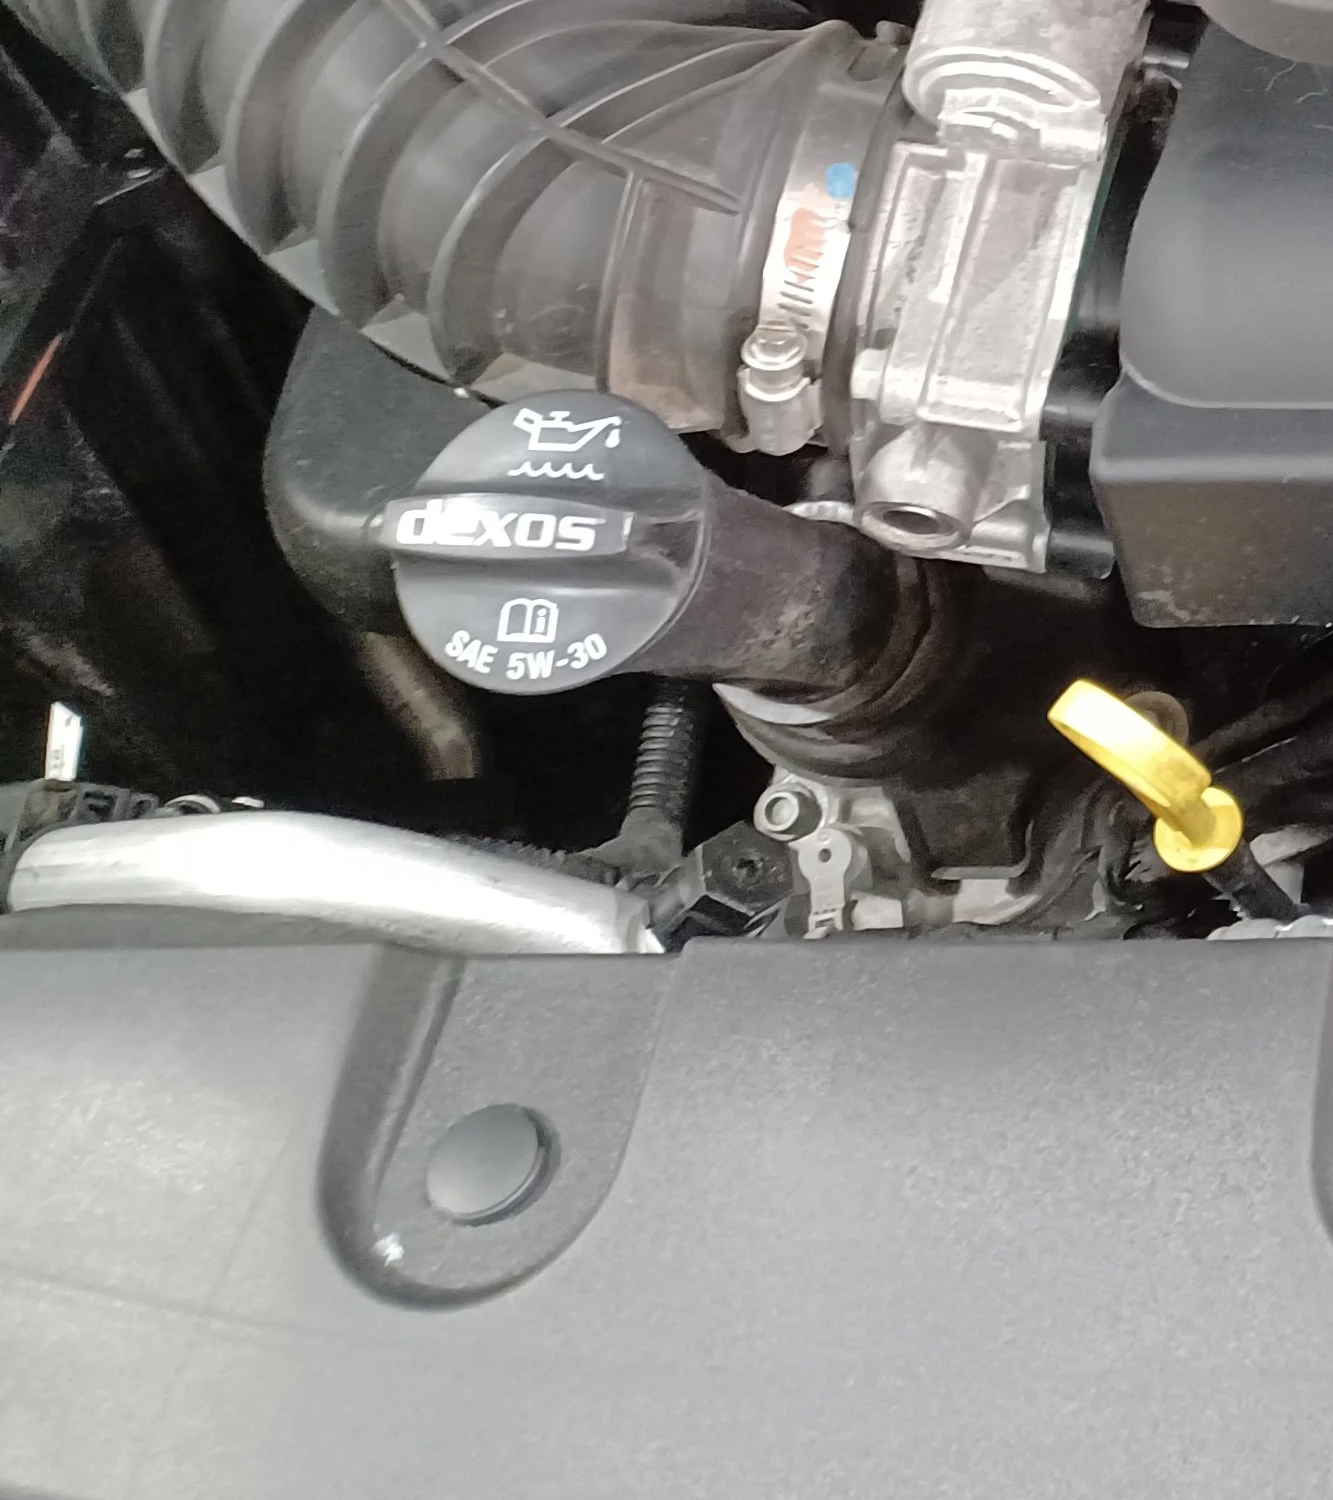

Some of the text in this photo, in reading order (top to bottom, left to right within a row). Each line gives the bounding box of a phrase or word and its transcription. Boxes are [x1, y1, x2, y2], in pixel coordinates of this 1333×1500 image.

[396, 499, 607, 551] dexos
[444, 630, 608, 680] SAE 5W-30
